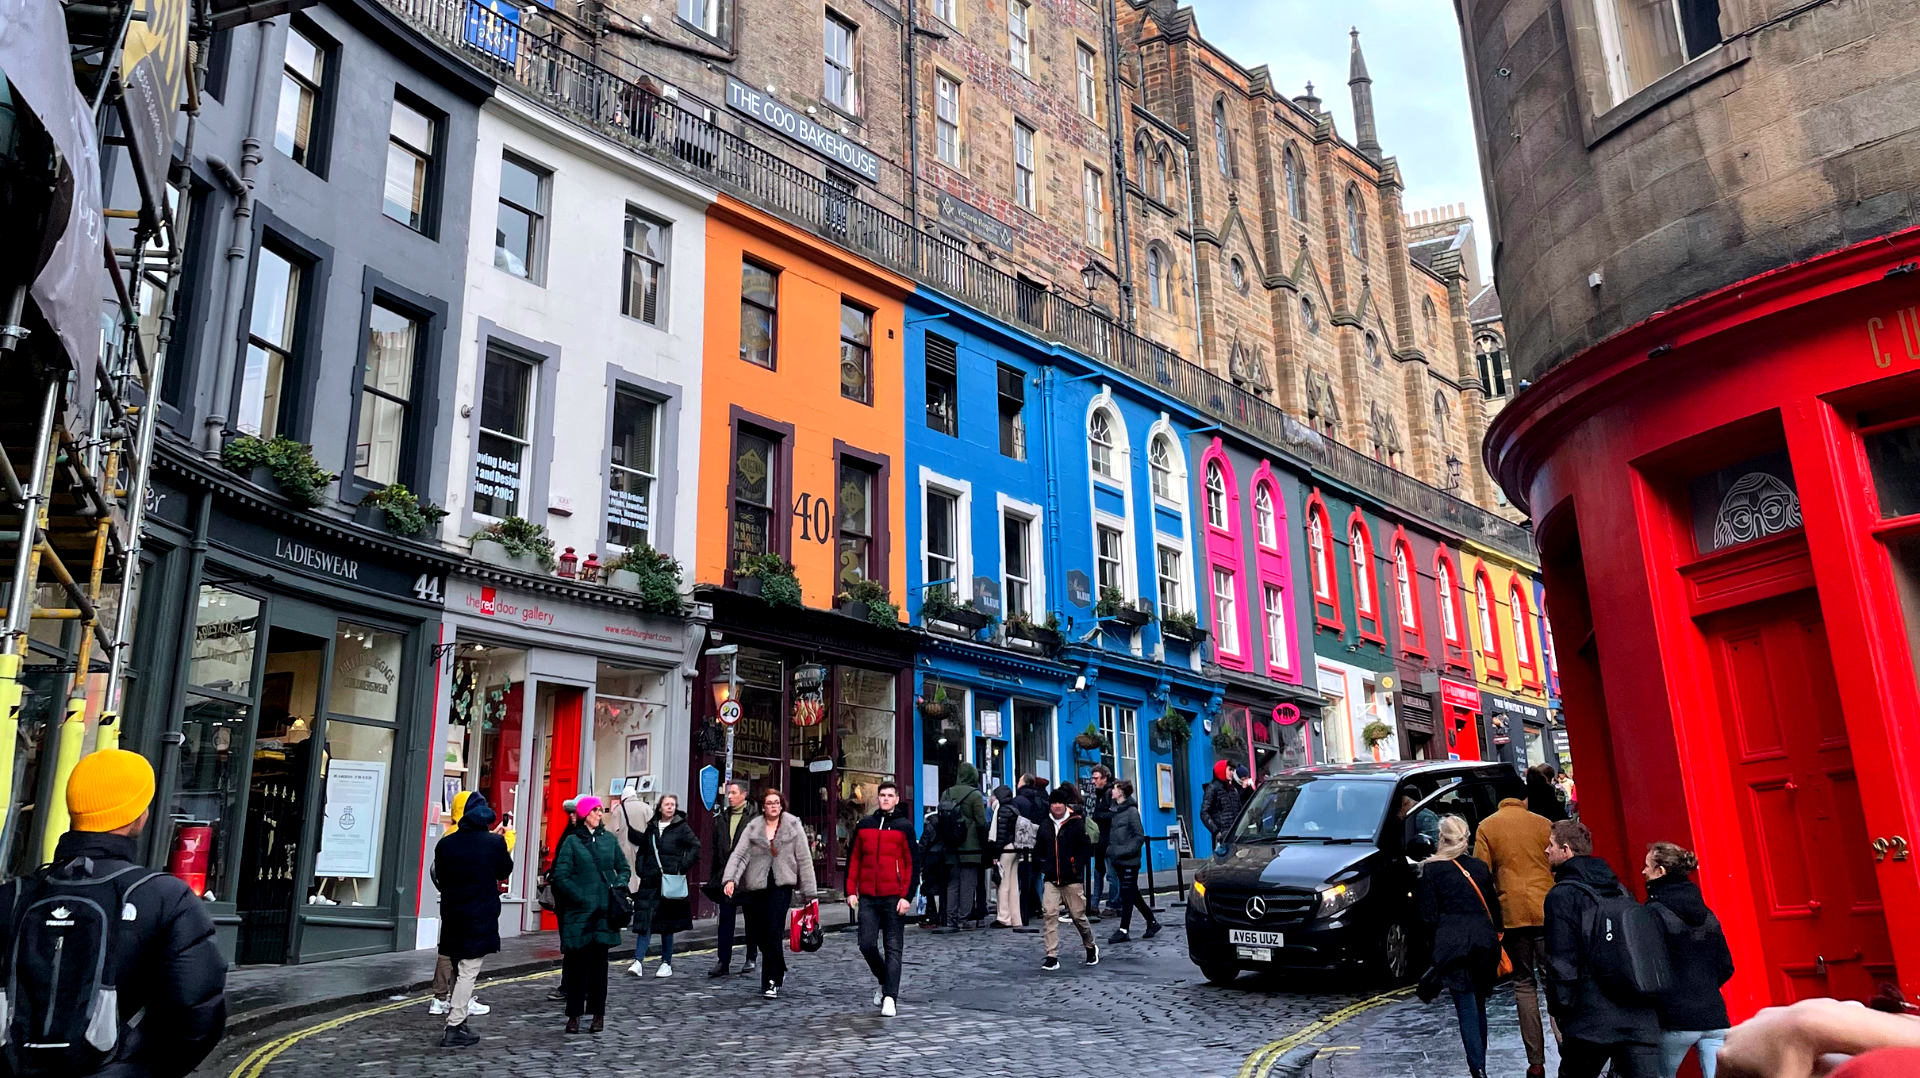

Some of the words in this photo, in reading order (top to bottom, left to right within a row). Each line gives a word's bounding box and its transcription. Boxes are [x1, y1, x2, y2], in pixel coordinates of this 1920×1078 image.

[730, 82, 761, 115] THE
[764, 102, 796, 133] COO
[799, 120, 876, 177] BAKEHOUSE
[477, 452, 498, 469] oving
[498, 457, 519, 473] Local
[479, 467, 495, 481] and
[494, 471, 521, 489] Design
[494, 485, 515, 502] 2003
[734, 520, 762, 534] WORLD
[793, 492, 830, 545] 40
[734, 531, 761, 544] AMOUS
[275, 538, 359, 580] LADIESWEAR
[983, 596, 1000, 609] BLEUE
[1076, 591, 1091, 602] BLEUE
[465, 592, 480, 608] the
[481, 596, 495, 612] red
[496, 600, 518, 616] door
[521, 605, 555, 626] gallery
[814, 632, 838, 646] HARRY
[839, 637, 866, 651] POTTER
[722, 706, 739, 718] 20
[1493, 698, 1504, 709] THE
[1524, 706, 1538, 717] SHOP
[733, 716, 773, 743] USEUM
[734, 738, 763, 754] ONTEXT
[1872, 836, 1909, 860] 92
[1233, 931, 1257, 943] AY66
[1260, 933, 1279, 945] UUZ
